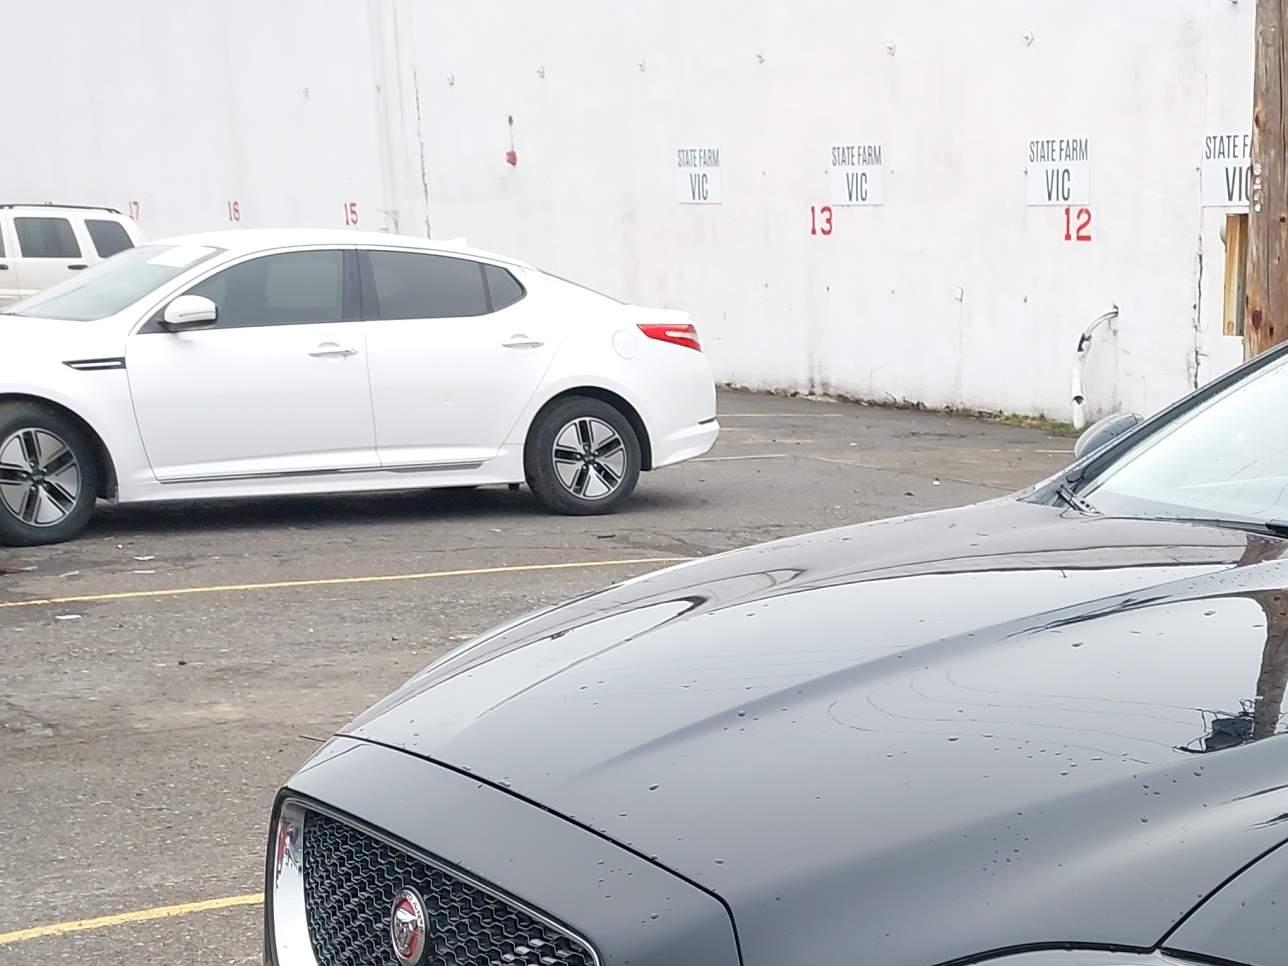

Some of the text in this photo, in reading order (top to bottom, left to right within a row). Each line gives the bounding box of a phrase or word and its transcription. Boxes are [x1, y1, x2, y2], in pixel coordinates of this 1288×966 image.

[677, 148, 720, 168] STATE FARM
[832, 144, 882, 167] STATE FARM
[1029, 138, 1088, 163] STATE FARM
[1205, 135, 1239, 160] STATE
[689, 173, 709, 201] VIC
[846, 172, 868, 202] VIC
[1045, 168, 1071, 202] VIC
[343, 202, 359, 225] 15
[811, 205, 833, 236] 13
[1064, 207, 1092, 241] 12
